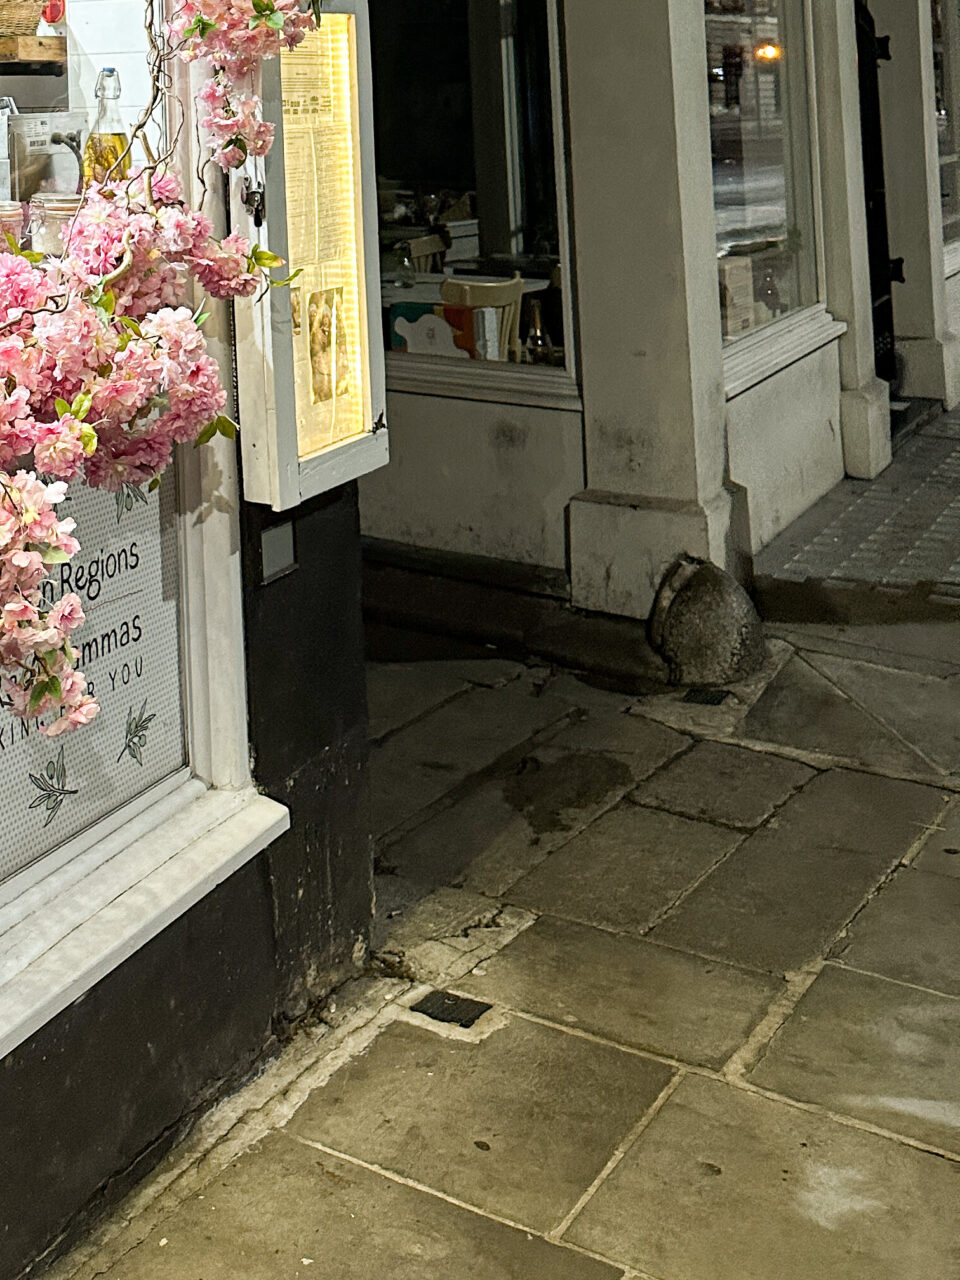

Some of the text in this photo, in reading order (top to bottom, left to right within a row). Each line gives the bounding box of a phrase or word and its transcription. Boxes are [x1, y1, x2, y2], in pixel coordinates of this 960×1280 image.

[61, 542, 139, 601] Regions
[71, 615, 142, 671] ammas
[108, 656, 143, 691] YOU
